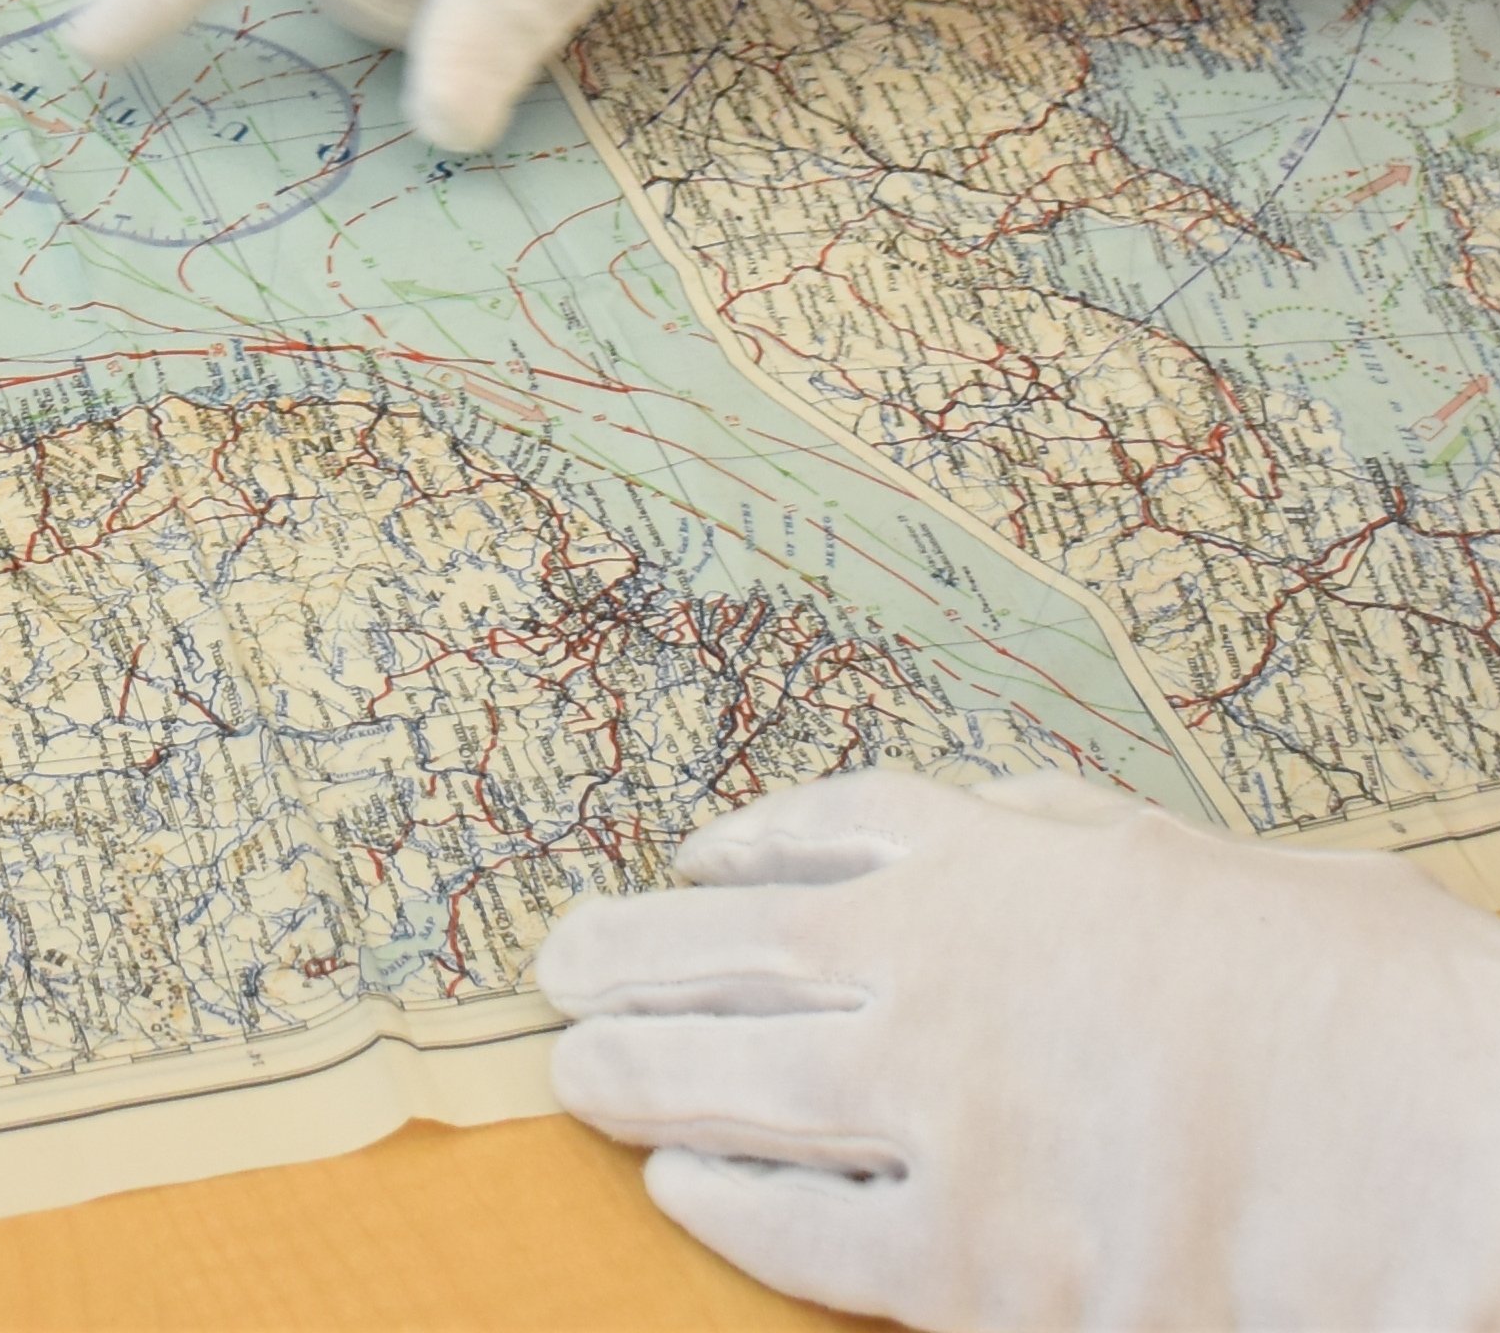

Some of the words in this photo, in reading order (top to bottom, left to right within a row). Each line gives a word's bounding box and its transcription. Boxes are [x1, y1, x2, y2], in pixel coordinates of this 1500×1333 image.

[329, 280, 342, 289] 6
[506, 359, 523, 376] 22
[783, 514, 795, 536] THE
[784, 540, 796, 557] OF
[822, 514, 836, 568] MEKONG
[946, 608, 961, 623] 15
[222, 681, 247, 728] Stung
